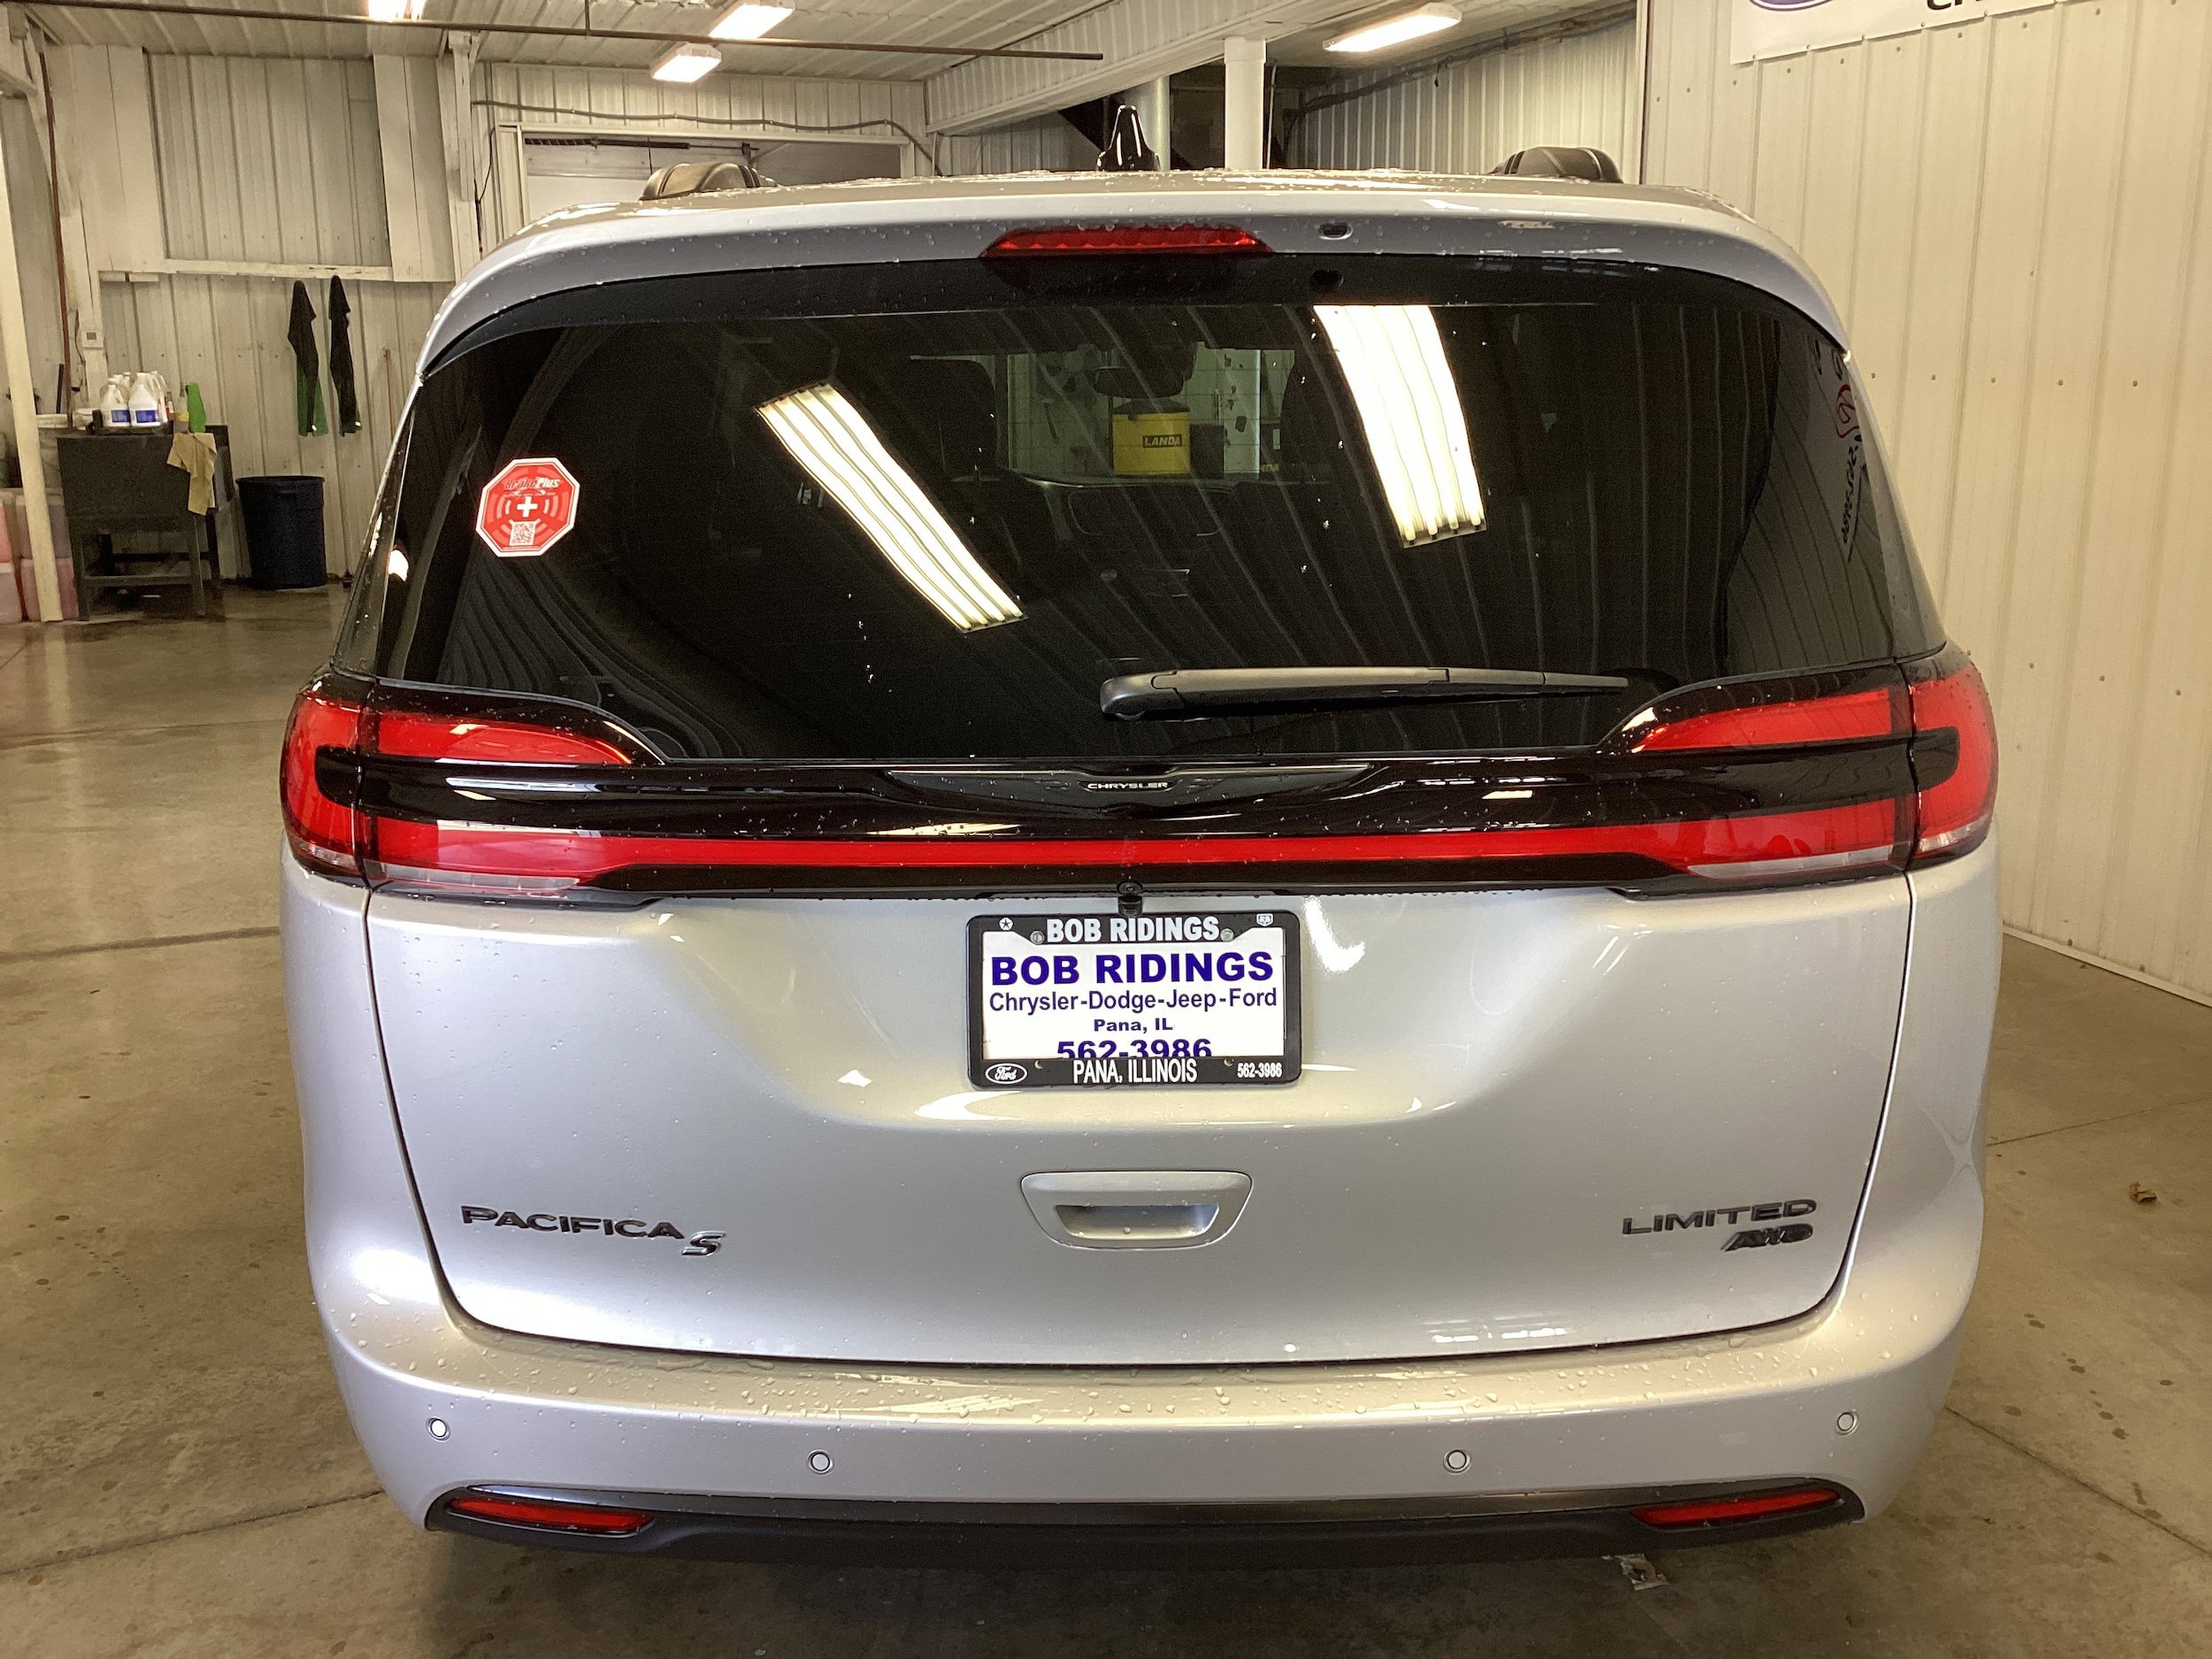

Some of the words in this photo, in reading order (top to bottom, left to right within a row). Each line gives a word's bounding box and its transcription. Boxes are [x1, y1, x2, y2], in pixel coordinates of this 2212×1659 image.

[1144, 436, 1181, 447] LANDA
[1047, 918, 1102, 942] BOB
[1110, 916, 1220, 942] RIDINGS
[992, 956, 1079, 986] BOB
[1096, 951, 1273, 984] RIDINGS
[1094, 1018, 1148, 1033] Pana,
[1155, 1018, 1173, 1031] IL
[1057, 1039, 1212, 1058] 562-3986
[995, 1066, 1017, 1081] Ford
[1073, 1059, 1123, 1083] PANA,
[1128, 1058, 1197, 1083] ILLINOIS
[1237, 1062, 1283, 1078] 562-3986
[1622, 1199, 1817, 1234] LIMITED
[461, 1205, 685, 1240] PACIFICA
[681, 1231, 726, 1256] S
[1721, 1223, 1814, 1251] AWD
